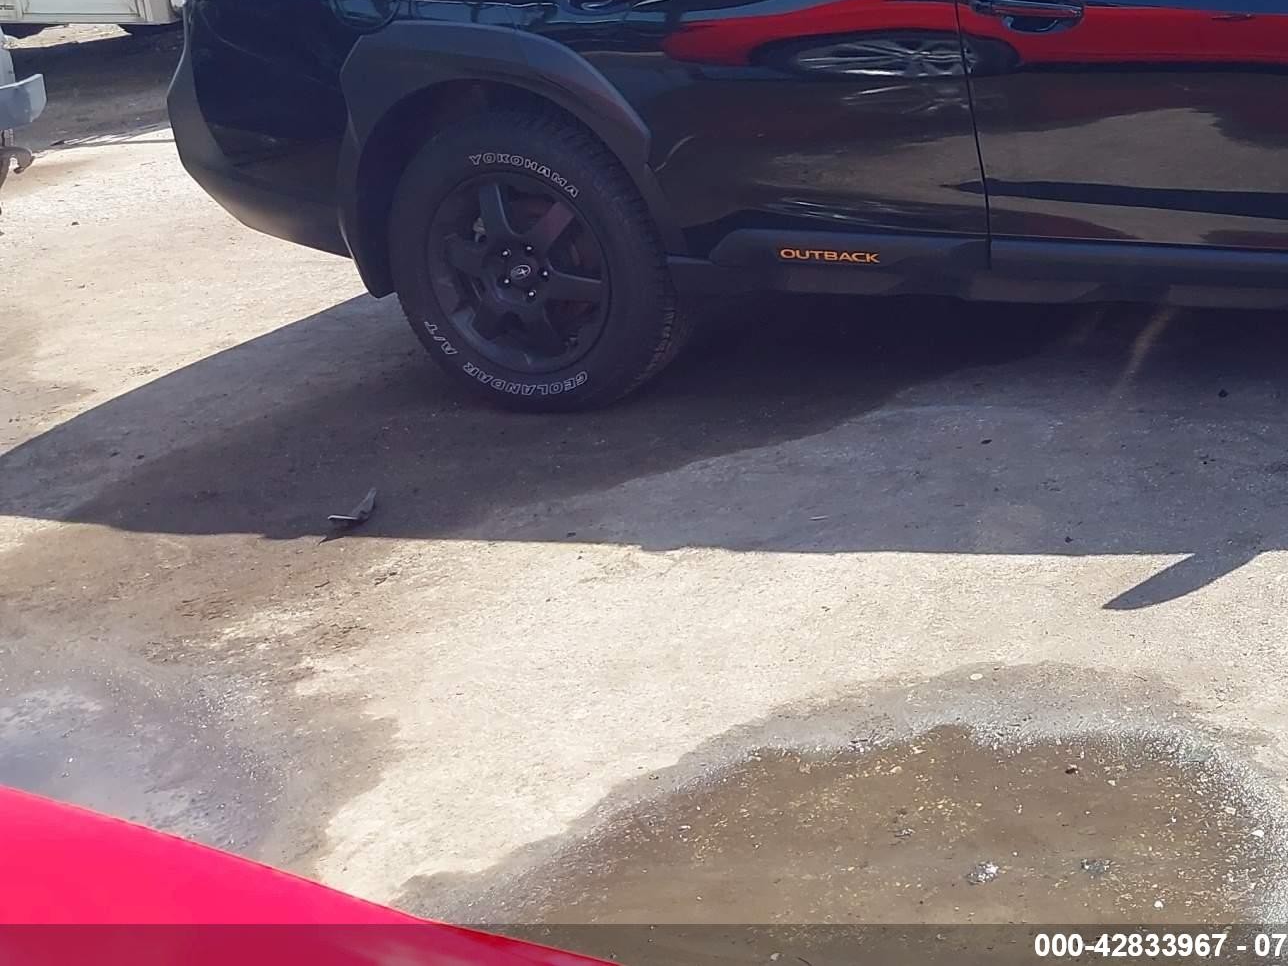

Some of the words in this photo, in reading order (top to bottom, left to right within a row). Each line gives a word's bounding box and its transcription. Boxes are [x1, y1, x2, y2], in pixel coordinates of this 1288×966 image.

[468, 152, 579, 198] YOKOHAMA
[780, 248, 880, 263] OUTBACK
[423, 321, 459, 355] A/T
[462, 361, 589, 395] GEOLANDAR
